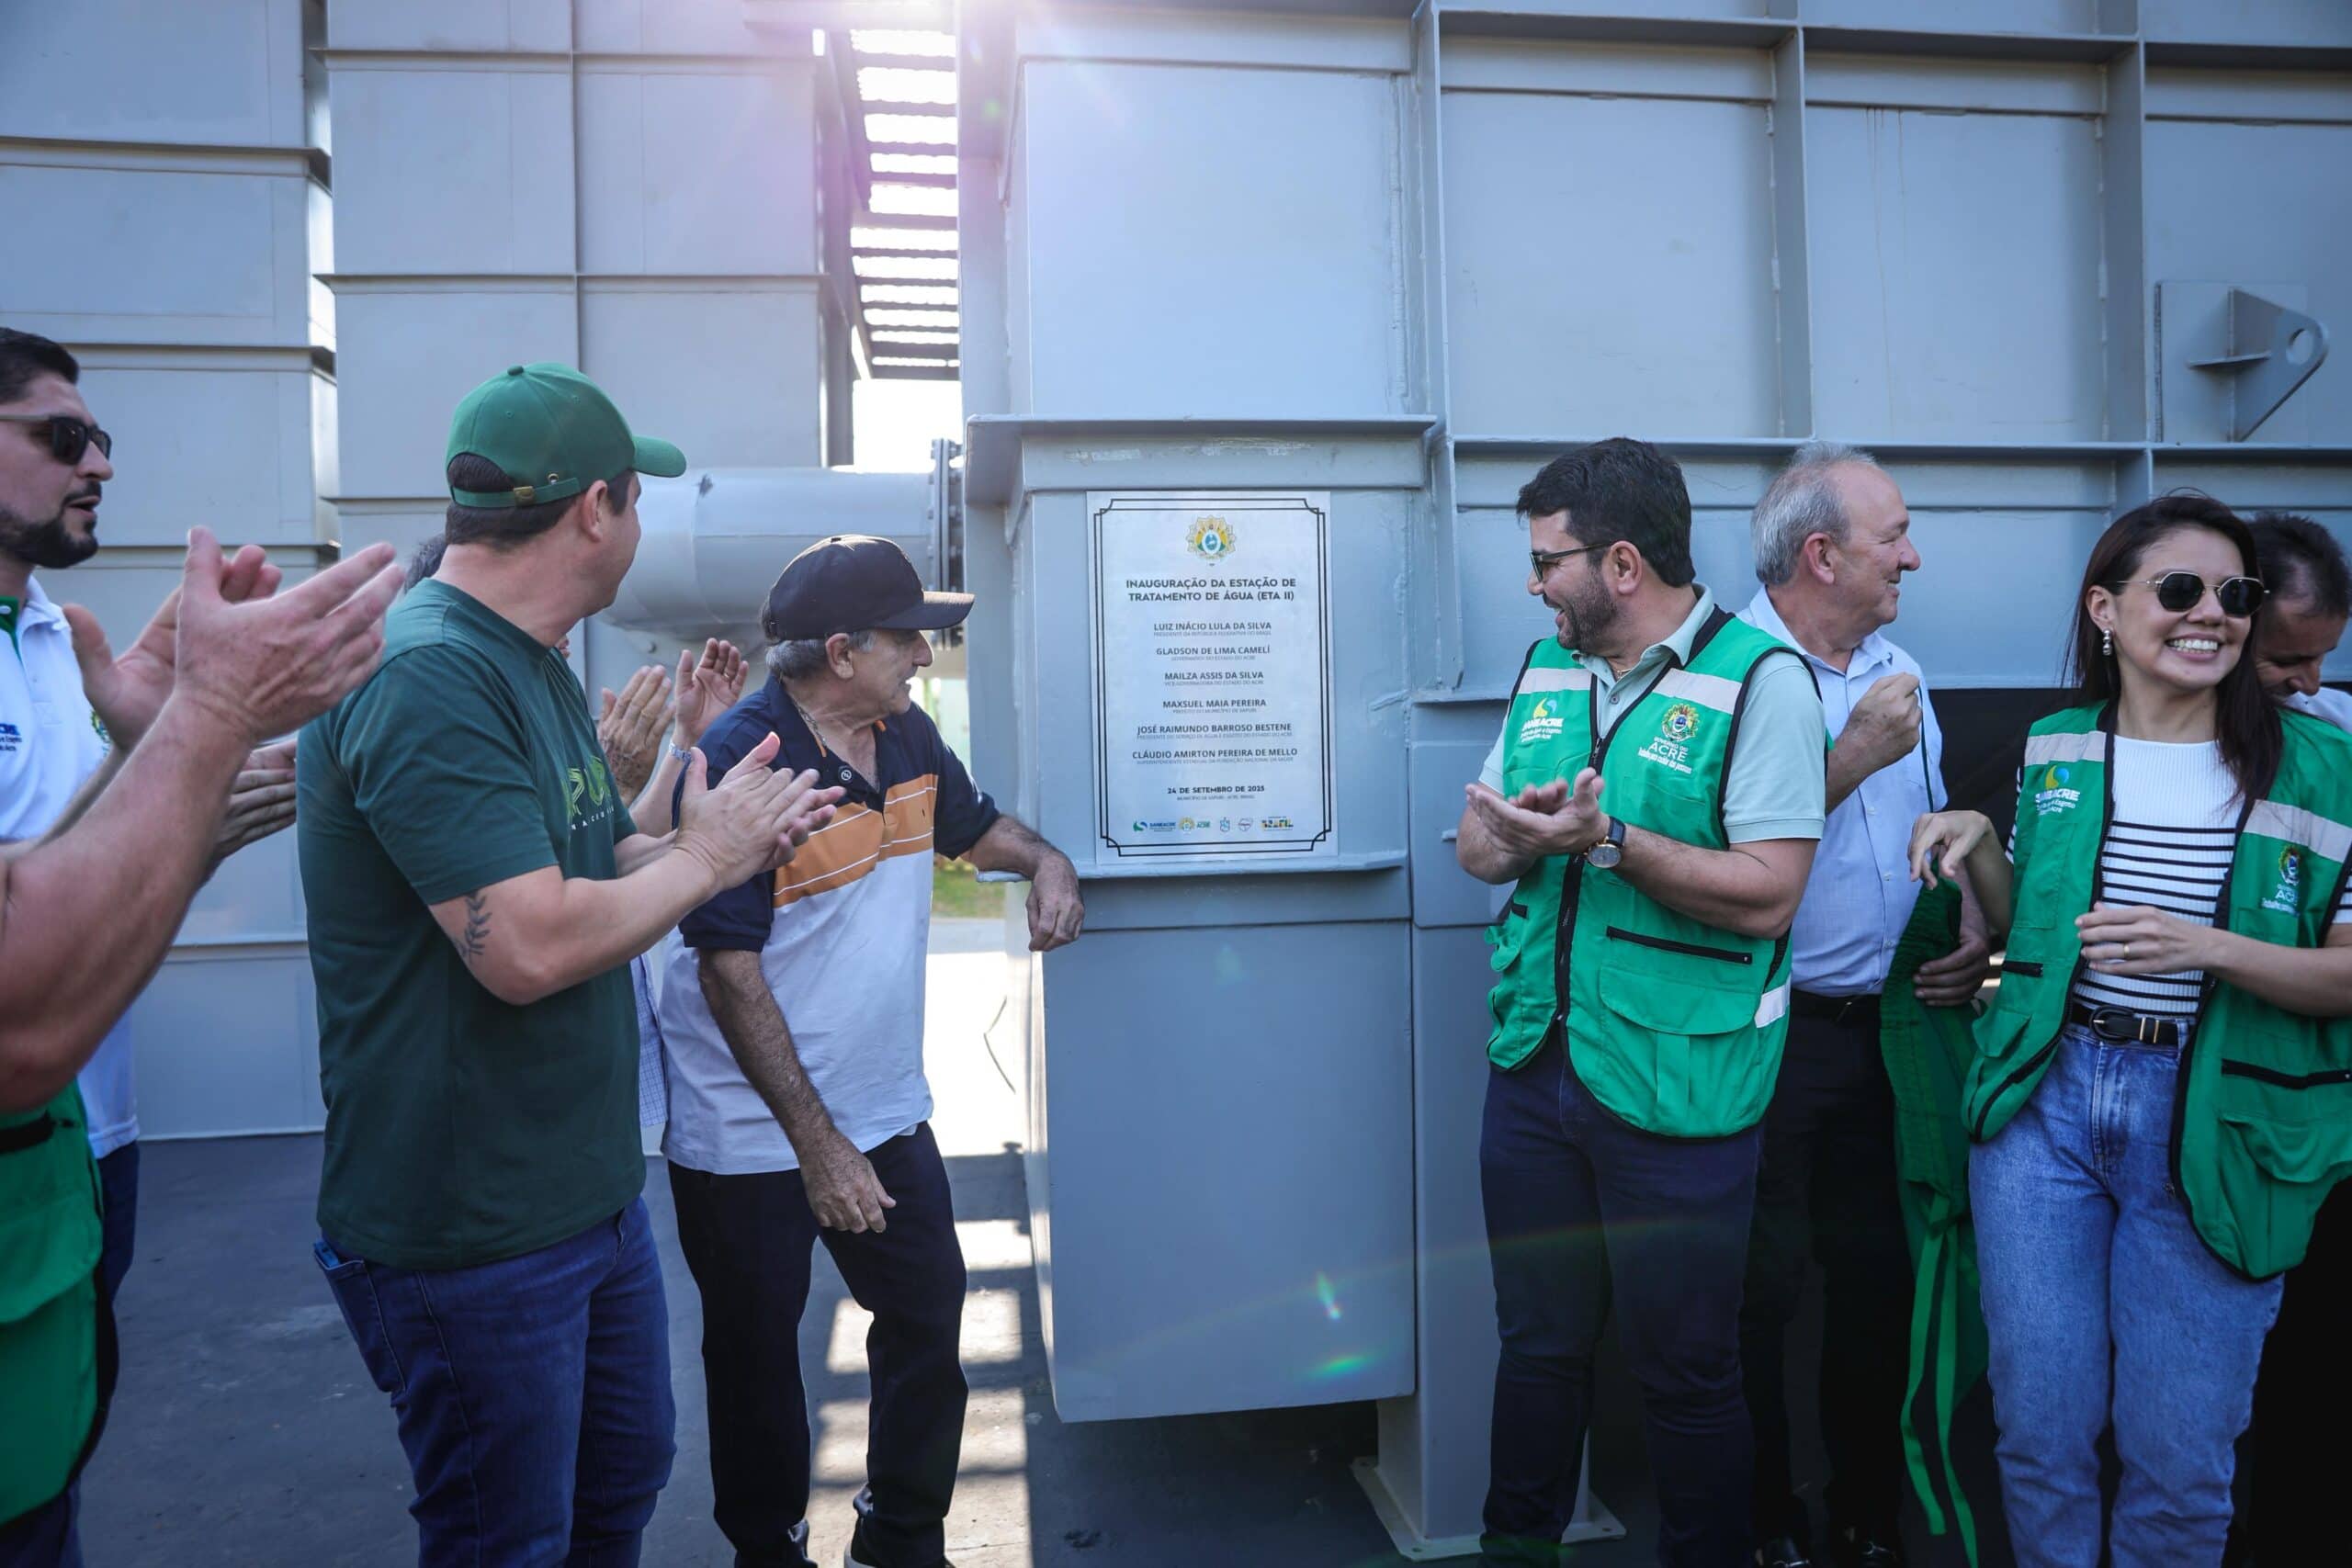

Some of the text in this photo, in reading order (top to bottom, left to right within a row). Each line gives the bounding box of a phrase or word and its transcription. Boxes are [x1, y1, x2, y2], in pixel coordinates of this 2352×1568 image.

[1125, 576, 1297, 590] INAUGURAÇÃO DA ESTAÇÃO DE
[1127, 590, 1295, 603] TRATAMENTO DE ÁGUA (ETA II)
[1153, 621, 1272, 632] LUIZ INÁCIO LULA DA SILVA
[1156, 648, 1199, 656] GLADSON
[1214, 647, 1237, 655] LIMA
[1238, 645, 1271, 655] CAMELÍ
[1164, 671, 1264, 681] MAILZA ASSIS DA SILVA
[1162, 699, 1267, 708] MAXSUEL MAIA PEREIRA
[1137, 723, 1293, 736] JOSÉ RAIMUNDO BARROSO BESTENE
[1132, 749, 1298, 760] CLÁUDIO AMIRTON PEREIRA DE MELLO
[1647, 741, 1689, 762] ACRE
[1167, 786, 1177, 795] 24
[1179, 786, 1191, 795] DE
[1192, 785, 1233, 795] SETEMBRO
[1235, 785, 1246, 794] DE
